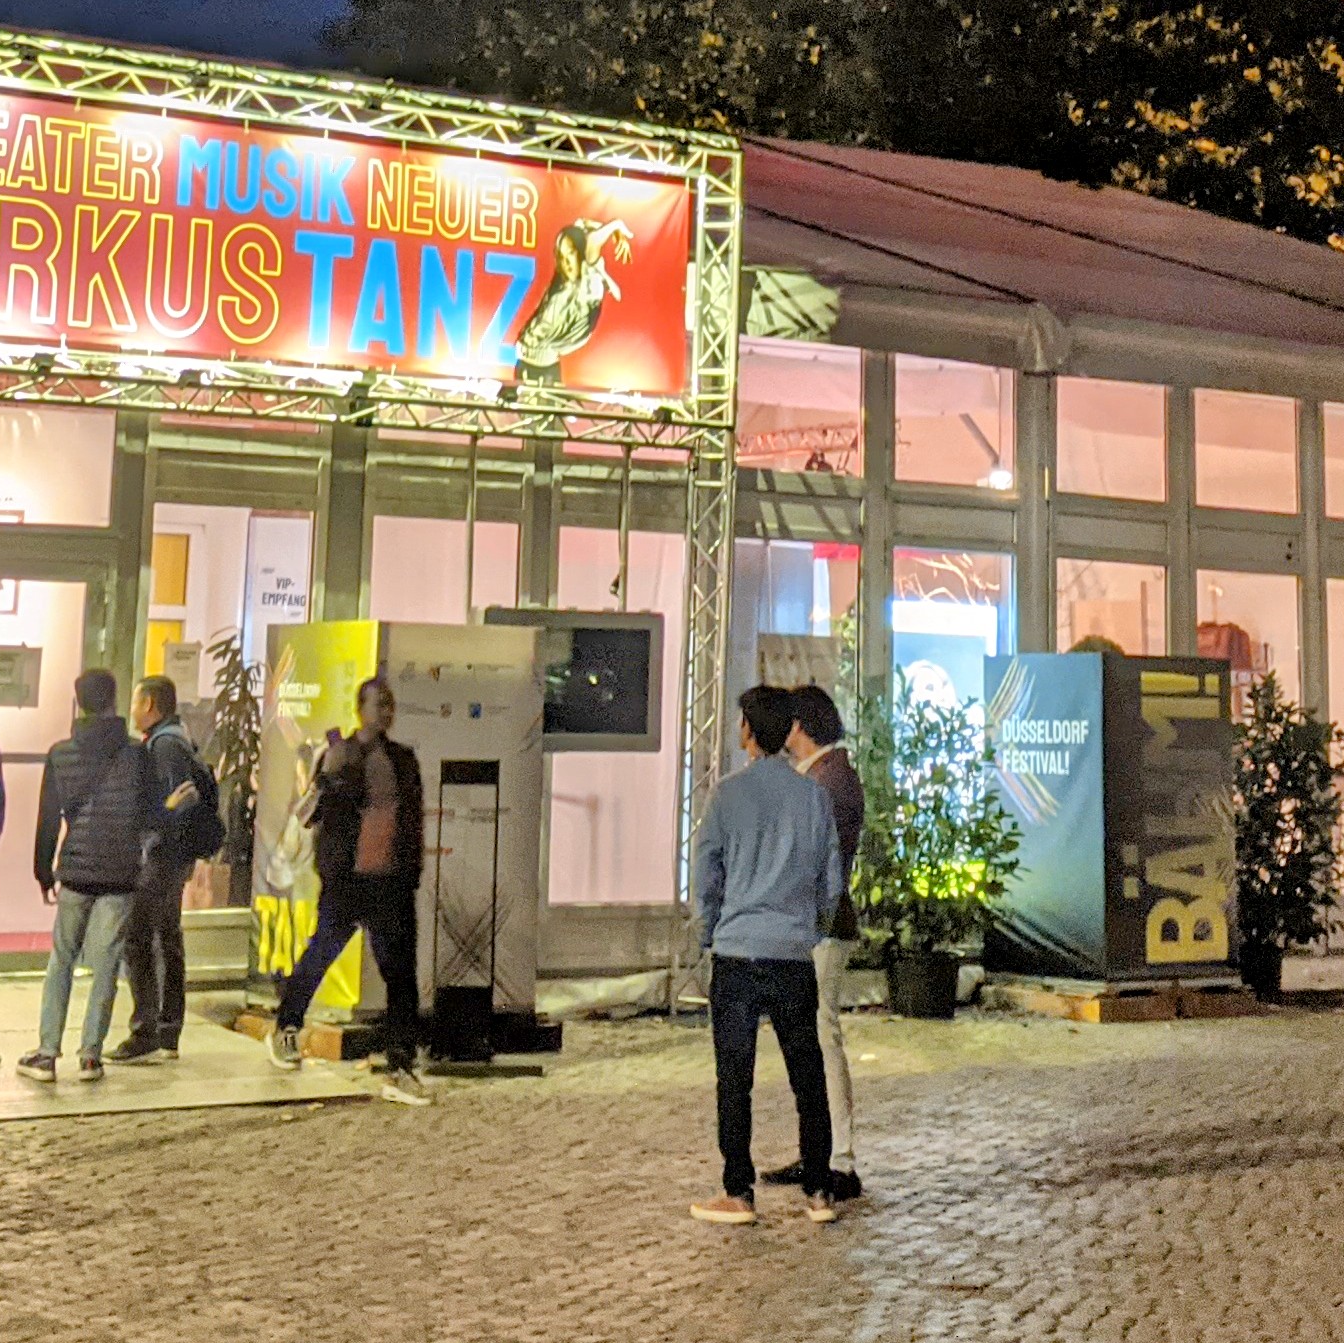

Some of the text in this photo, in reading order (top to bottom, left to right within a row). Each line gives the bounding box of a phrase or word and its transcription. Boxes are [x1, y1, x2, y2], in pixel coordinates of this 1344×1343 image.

[176, 135, 355, 226] MUSIK
[367, 158, 539, 248] NEUER
[294, 231, 536, 368] TANZ
[1002, 715, 1090, 746] DÜSSELDORF
[1002, 750, 1070, 776] FESTIVAL!
[1122, 670, 1229, 964] BÄHM!
